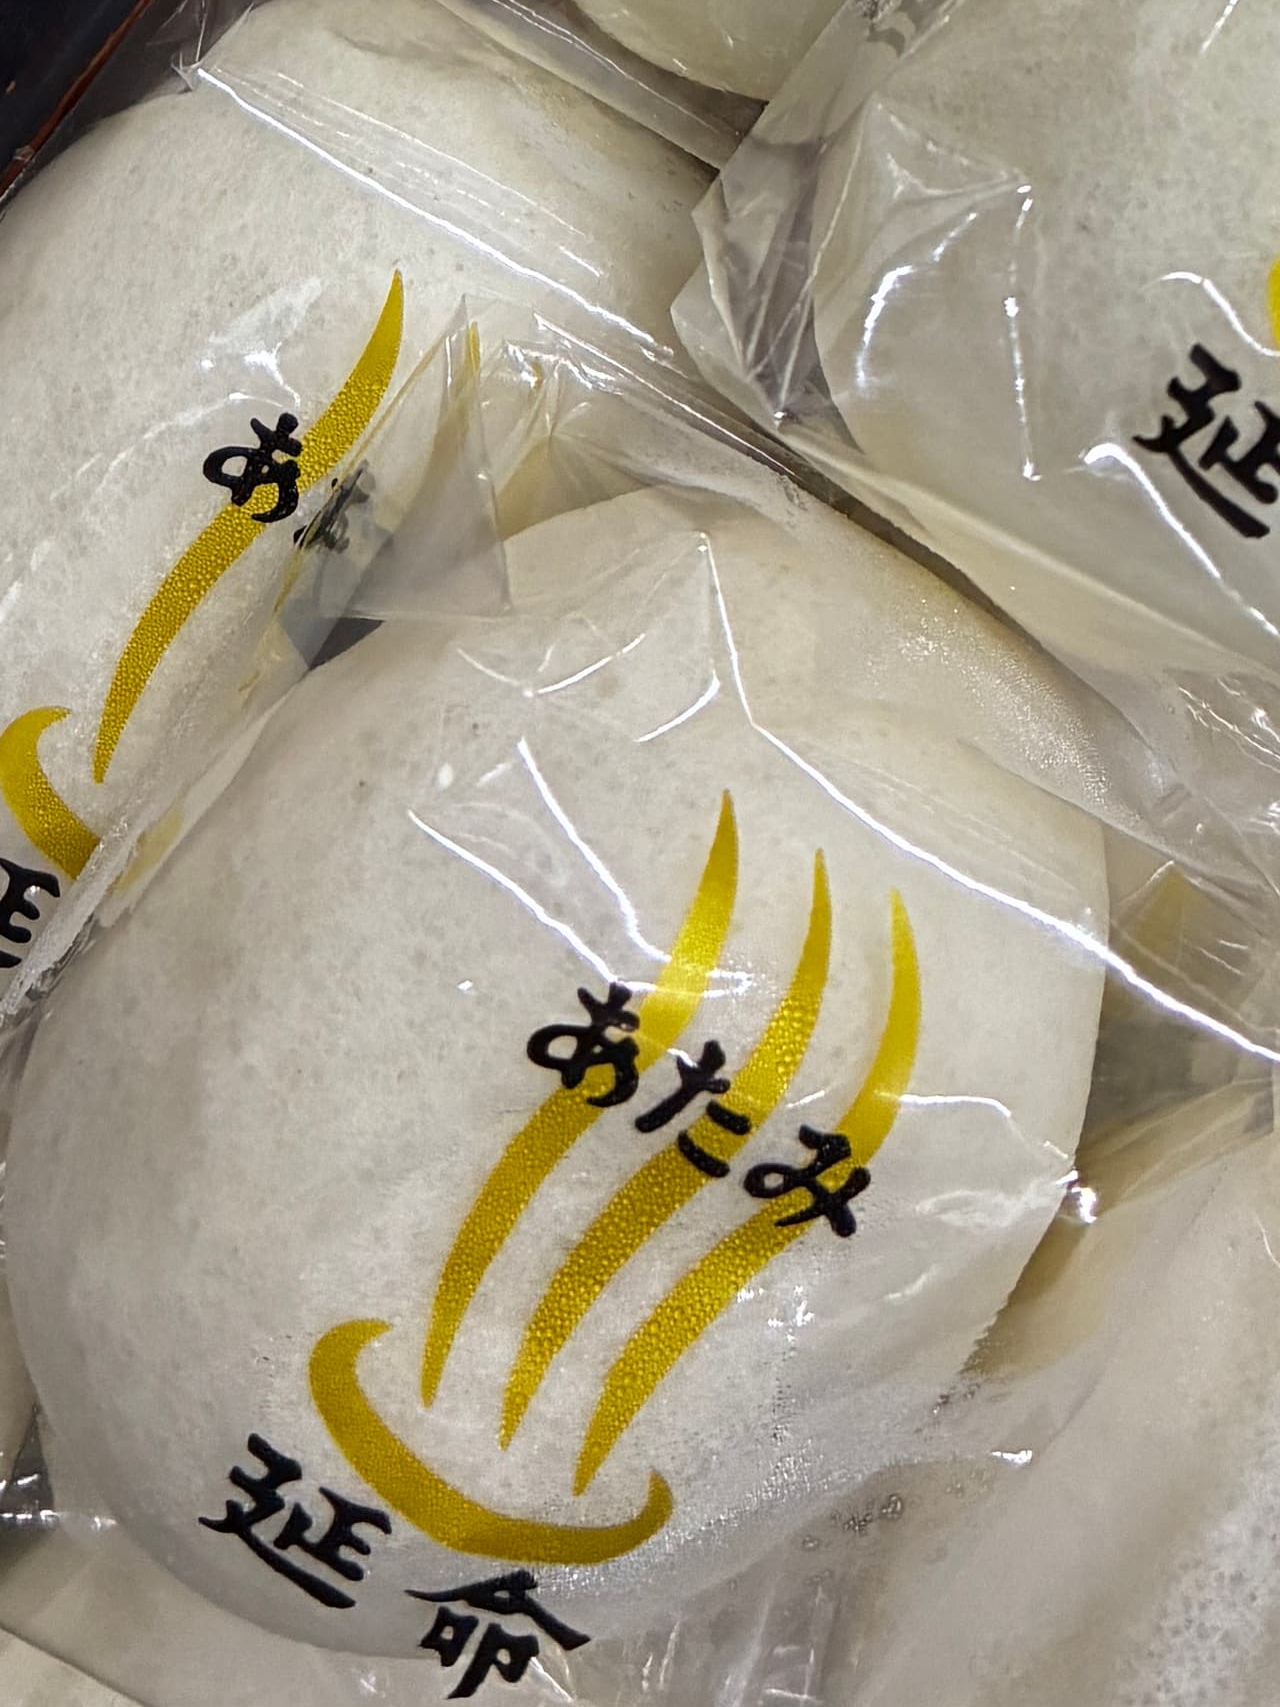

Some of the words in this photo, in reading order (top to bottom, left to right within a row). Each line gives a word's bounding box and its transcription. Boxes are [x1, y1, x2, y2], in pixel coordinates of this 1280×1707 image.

[527, 982, 872, 1239] あたみ
[197, 1432, 592, 1700] 延命
